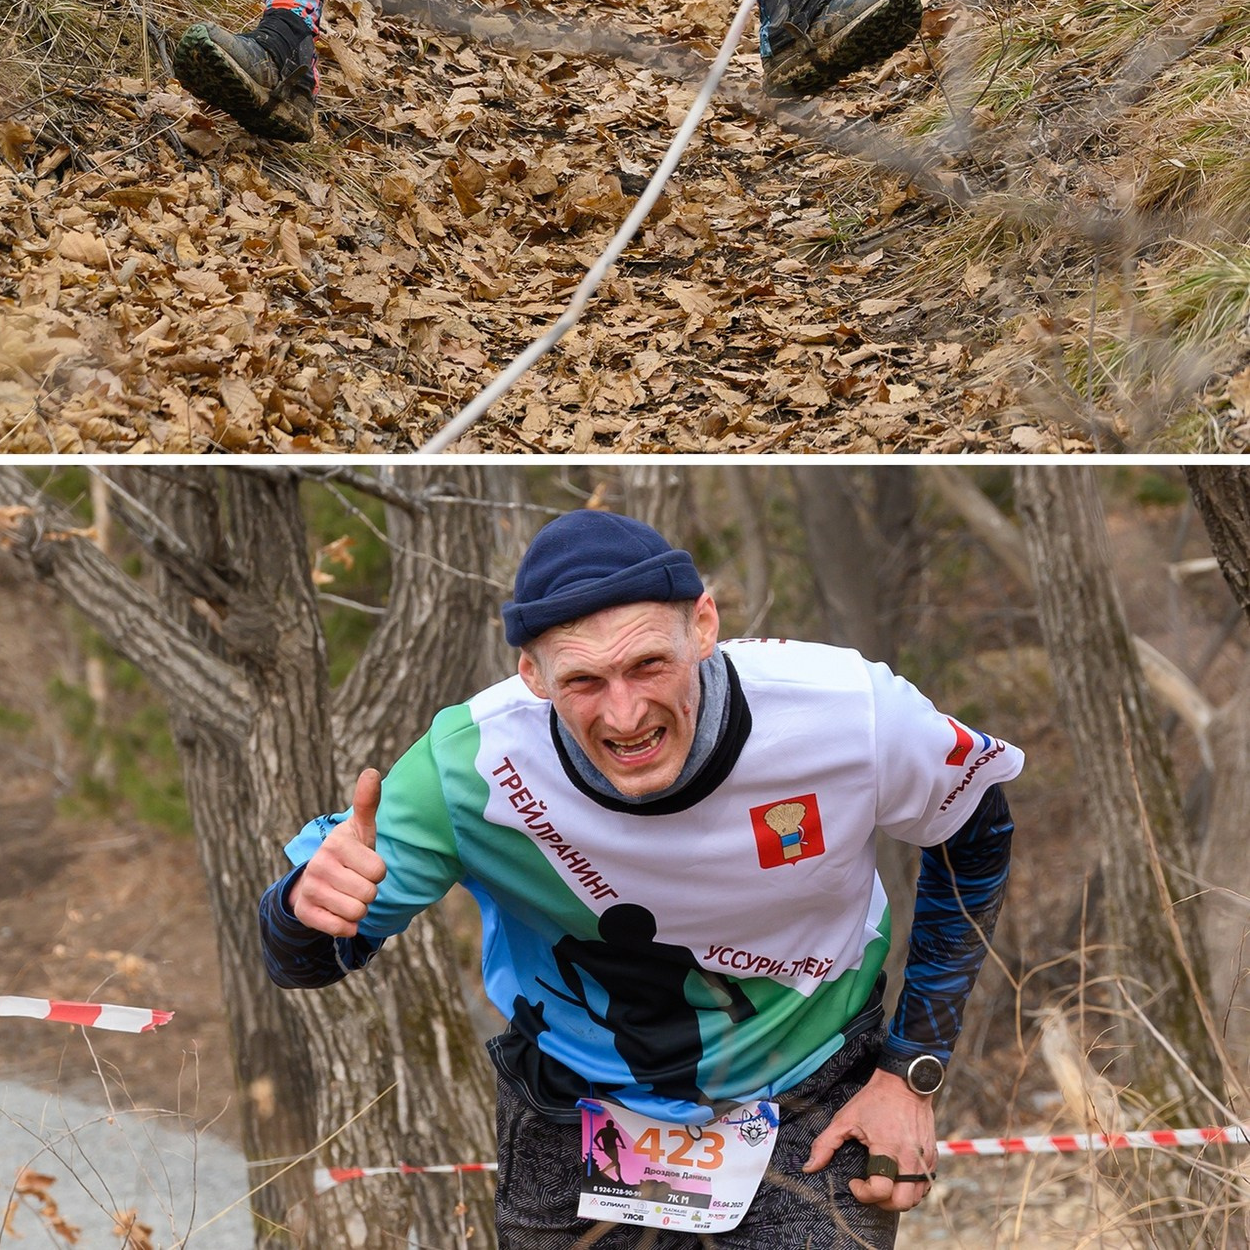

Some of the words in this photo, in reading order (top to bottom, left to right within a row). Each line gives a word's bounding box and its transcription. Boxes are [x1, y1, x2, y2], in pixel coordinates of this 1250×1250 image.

[491, 756, 620, 902] ТРЕЙЛРАНИНГ
[633, 1126, 726, 1171] 423
[643, 1166, 680, 1178] Дроздов
[681, 1172, 712, 1182] Данила
[667, 1193, 680, 1203] 7К
[681, 1195, 690, 1204] М
[599, 1201, 631, 1210] ОЛИМП
[622, 1213, 644, 1222] УЛОВ
